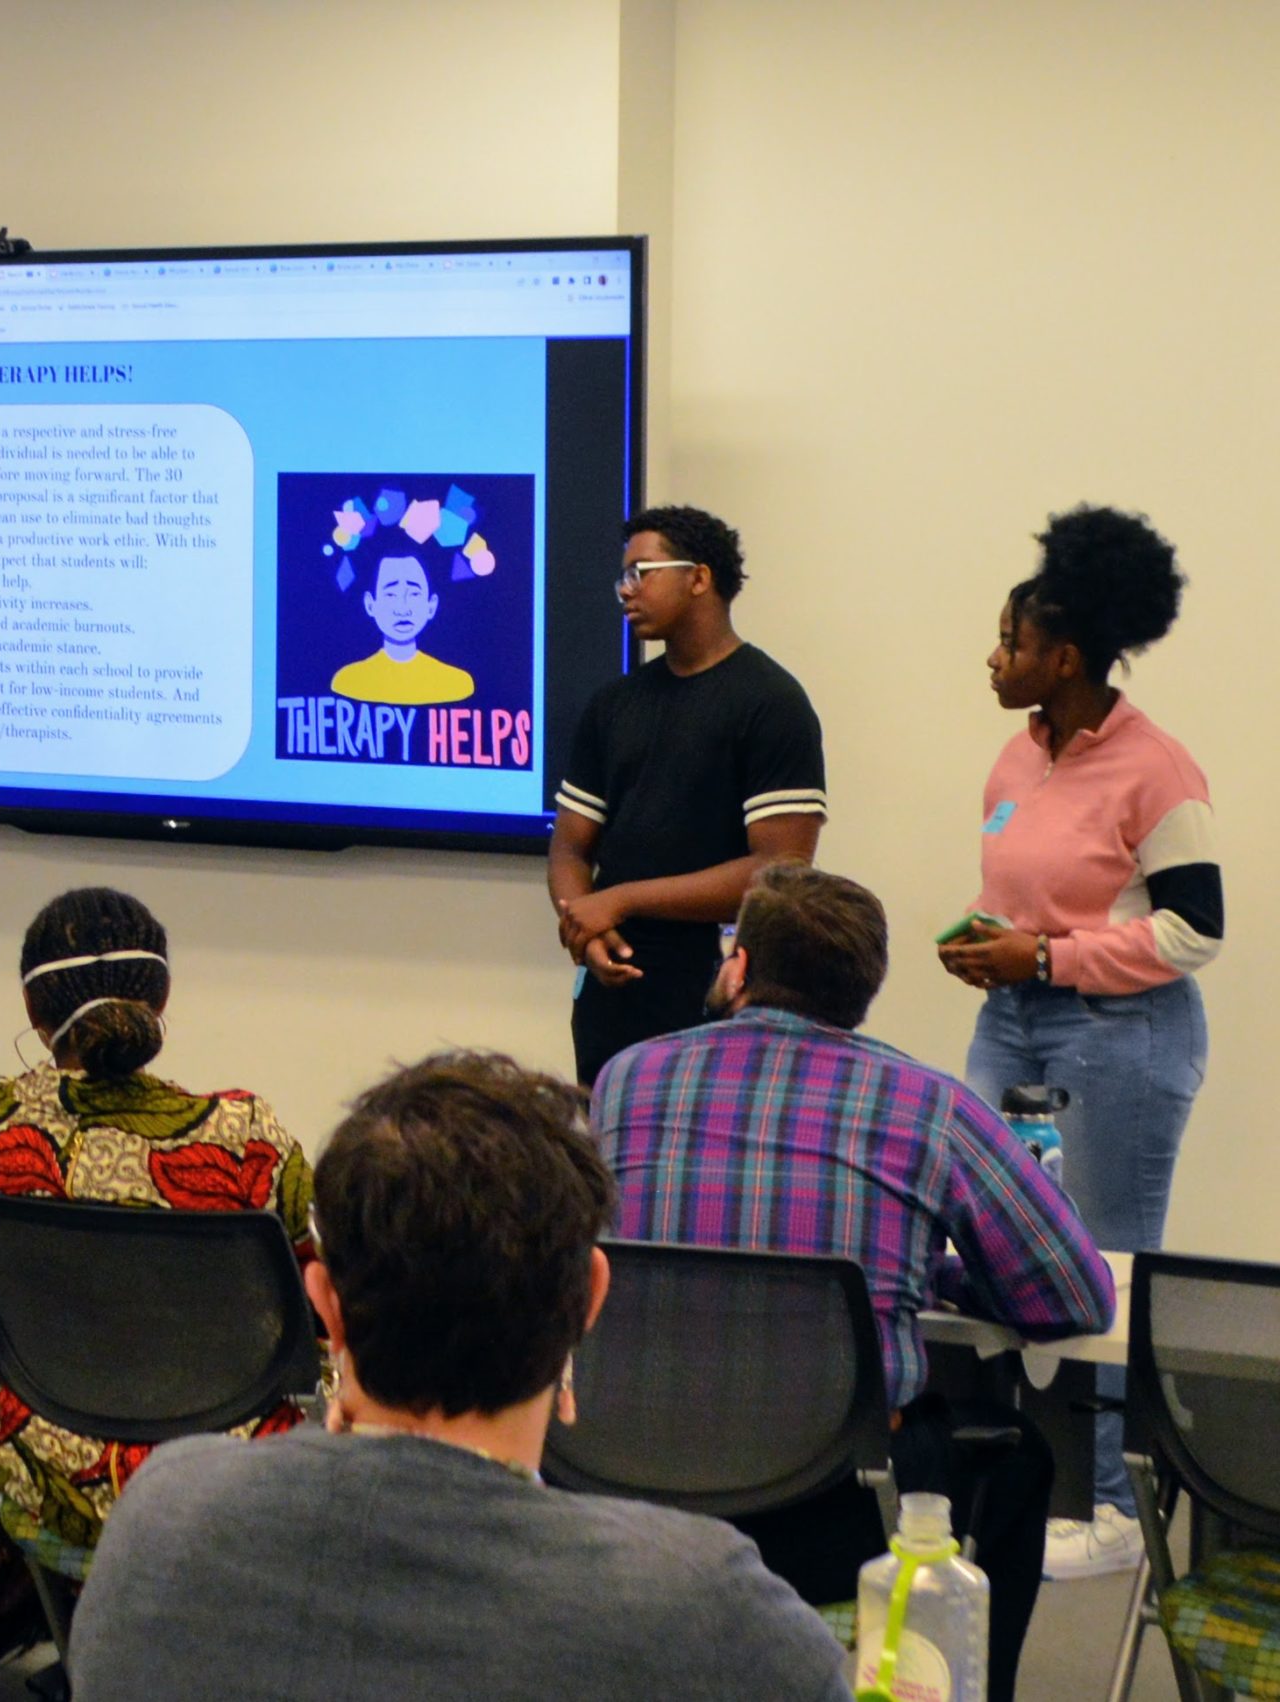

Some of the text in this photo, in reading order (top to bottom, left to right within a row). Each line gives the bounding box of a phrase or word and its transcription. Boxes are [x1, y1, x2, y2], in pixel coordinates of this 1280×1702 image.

[64, 364, 133, 383] HELPS!
[1, 428, 9, 439] a
[12, 424, 77, 443] respective
[80, 423, 104, 439] and
[106, 423, 178, 438] stress-free
[51, 445, 63, 460] is
[66, 444, 111, 460] needed
[114, 446, 129, 460] to
[131, 444, 148, 460] be
[150, 445, 178, 460] able
[181, 447, 196, 460] to
[23, 467, 72, 486] moving
[74, 466, 131, 482] forward.
[133, 466, 162, 482] The
[164, 467, 183, 482] 30
[52, 488, 65, 503] is
[66, 493, 75, 503] a
[78, 488, 146, 508] significant
[149, 488, 190, 504] factor
[191, 488, 220, 504] that
[20, 514, 43, 524] use
[45, 511, 60, 525] to
[62, 509, 123, 525] eliminate
[125, 510, 149, 525] bad
[152, 510, 212, 530] thoughts
[7, 530, 74, 550] productive
[77, 531, 110, 547] work
[112, 531, 150, 547] ethic.
[154, 532, 188, 548] With
[191, 532, 217, 548] this
[31, 552, 57, 568] that
[60, 552, 116, 568] students
[119, 553, 148, 569] will:
[2, 572, 31, 593] help.
[31, 596, 93, 612] increases.
[12, 616, 70, 633] academic
[74, 617, 135, 634] burnouts.
[56, 640, 102, 655] stance.
[15, 659, 56, 675] within
[59, 661, 89, 676] each
[92, 661, 133, 678] school
[137, 664, 151, 678] to
[154, 664, 203, 683] provide
[8, 680, 28, 696] for
[31, 681, 104, 699] low-income
[107, 684, 167, 701] students.
[172, 686, 200, 702] And
[50, 703, 142, 726] confidentiality
[145, 711, 223, 727] agreements
[277, 696, 531, 766] THERAPY HELPS
